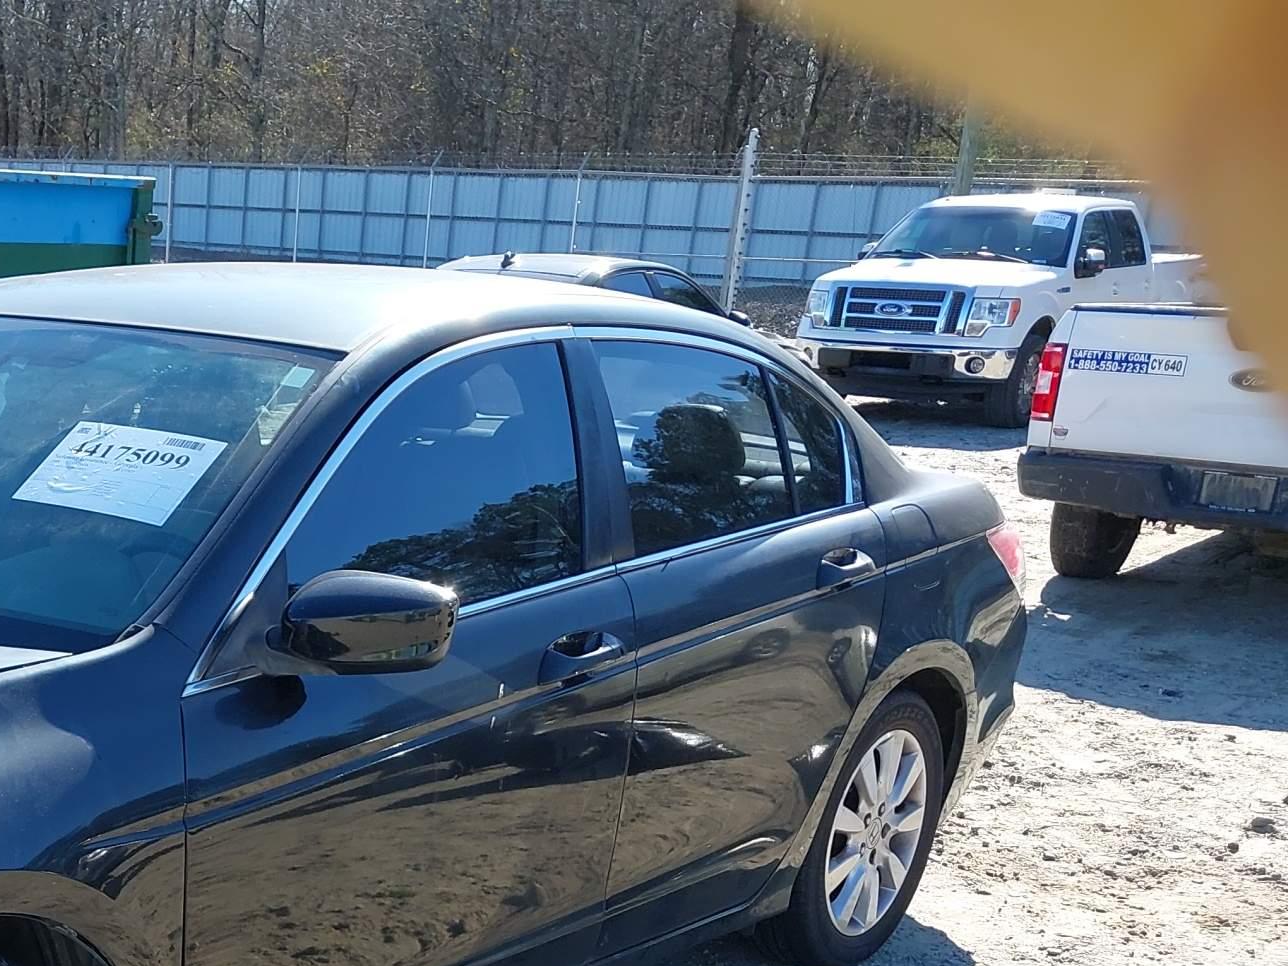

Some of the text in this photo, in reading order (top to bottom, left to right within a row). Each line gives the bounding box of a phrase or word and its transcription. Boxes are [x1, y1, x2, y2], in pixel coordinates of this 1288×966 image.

[1073, 349, 1150, 362] SAFETY IS MY GOAL
[1070, 359, 1148, 374] 1-888-550-7233
[1151, 359, 1183, 372] CY 640
[70, 441, 191, 470] 44175099
